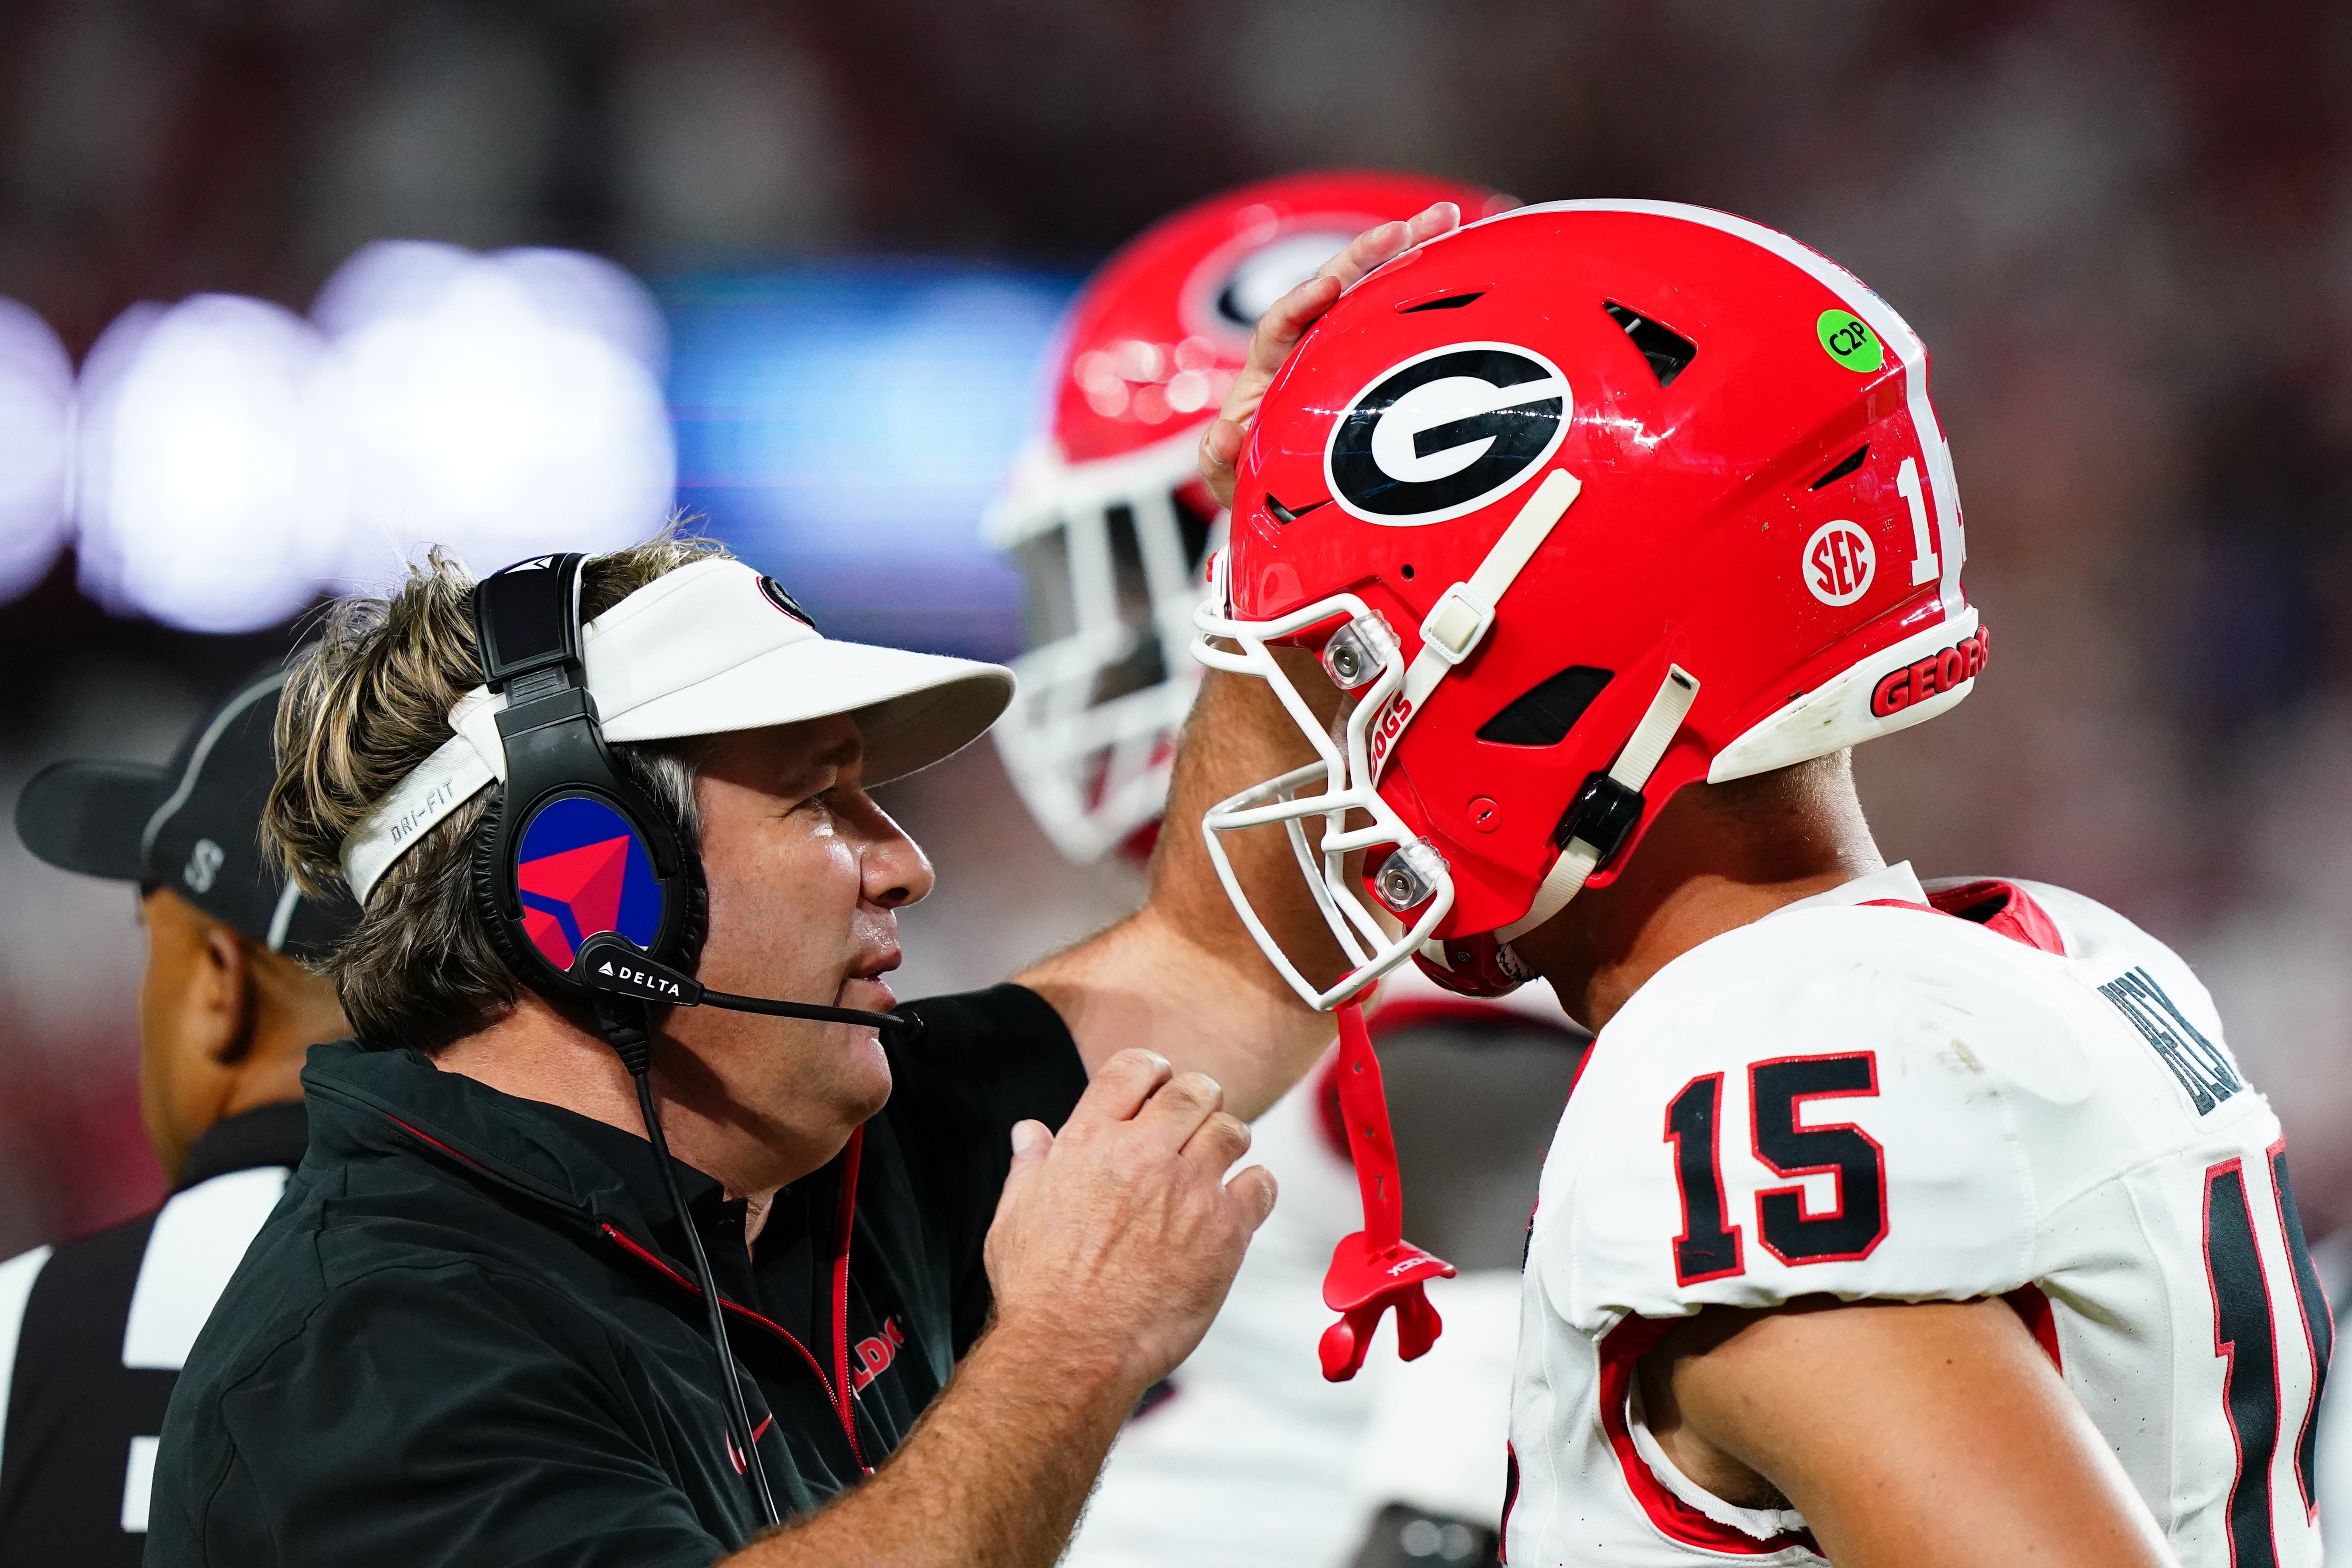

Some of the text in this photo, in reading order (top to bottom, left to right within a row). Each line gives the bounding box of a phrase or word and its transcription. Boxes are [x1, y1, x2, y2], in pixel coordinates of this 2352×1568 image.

[1829, 321, 1867, 356] C2P
[1811, 530, 1868, 596] SEC
[390, 777, 453, 845] DRI-FIT
[183, 838, 224, 893] S
[619, 966, 679, 997] DELTA
[1663, 1050, 1890, 1288] 15
